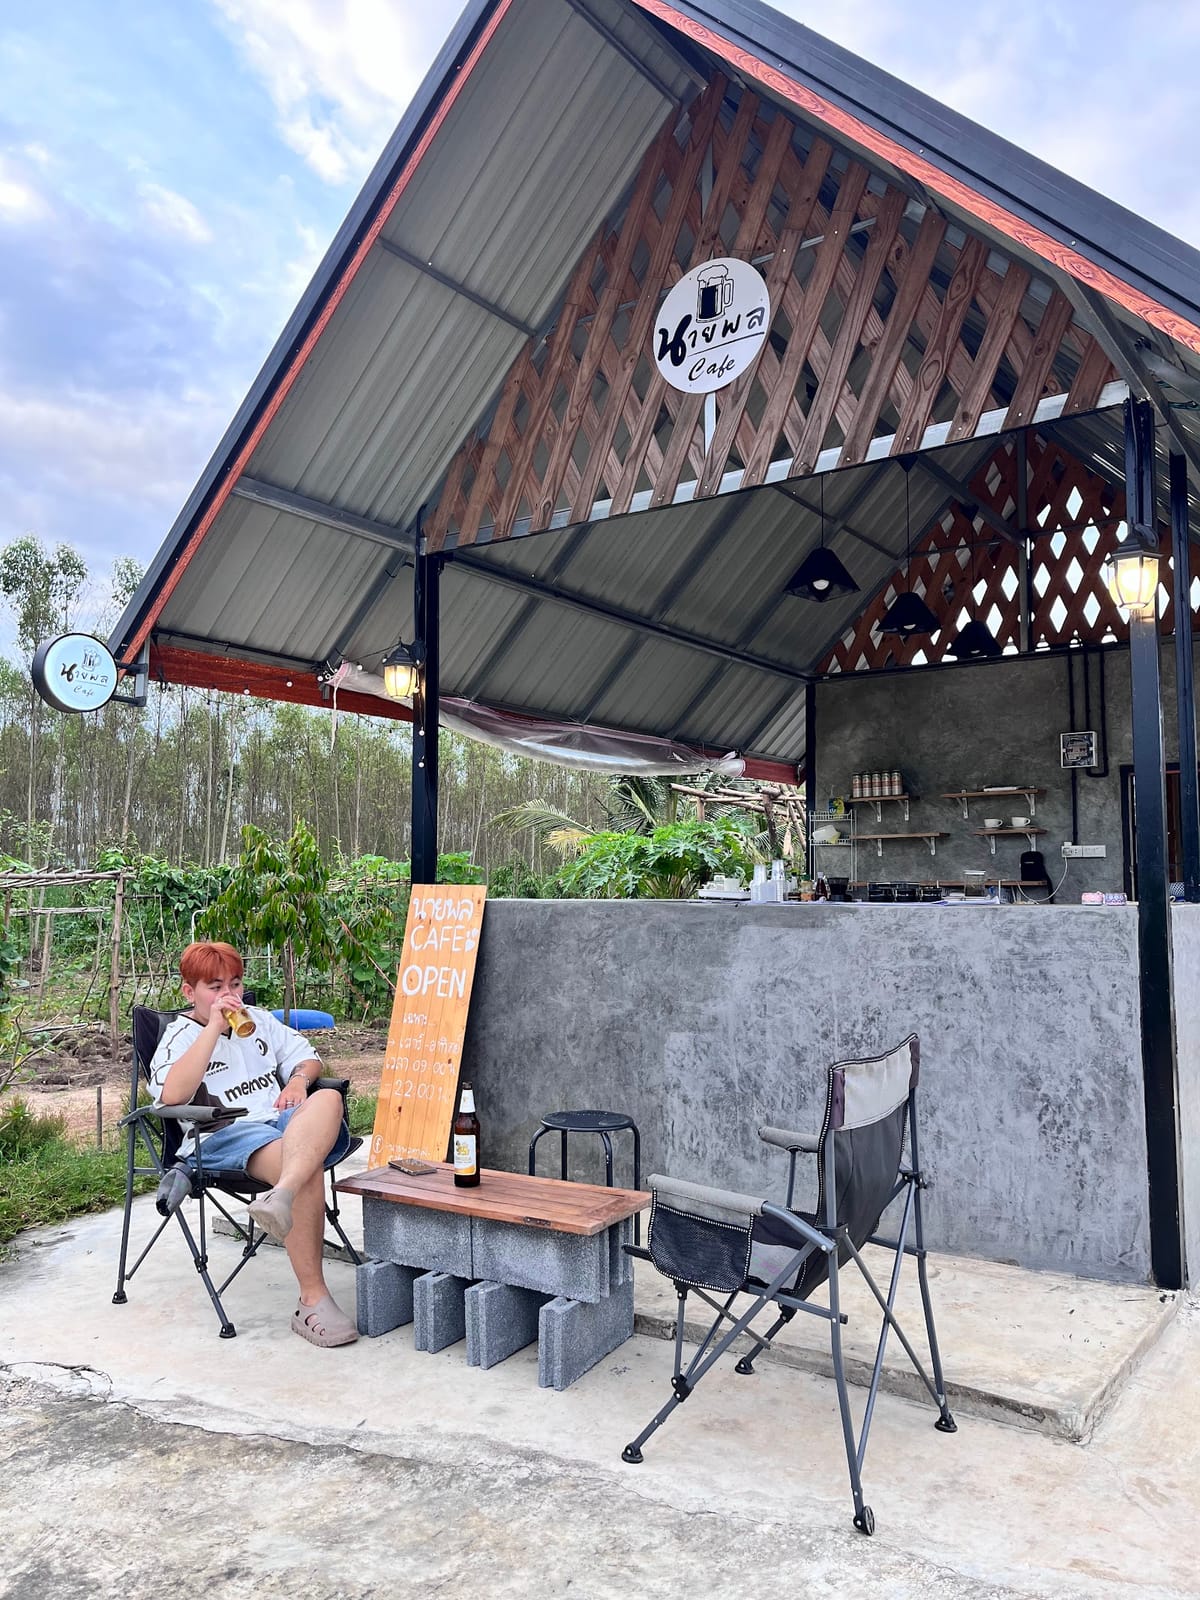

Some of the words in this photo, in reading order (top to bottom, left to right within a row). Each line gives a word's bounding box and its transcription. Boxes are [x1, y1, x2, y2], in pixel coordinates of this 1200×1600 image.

[658, 306, 766, 367] นายพล
[688, 354, 736, 382] Cafe
[60, 662, 109, 684] นายพล
[73, 685, 95, 697] Cafe
[412, 897, 475, 921] นายพล
[410, 924, 466, 952] CAFE
[402, 964, 467, 999] OPEN
